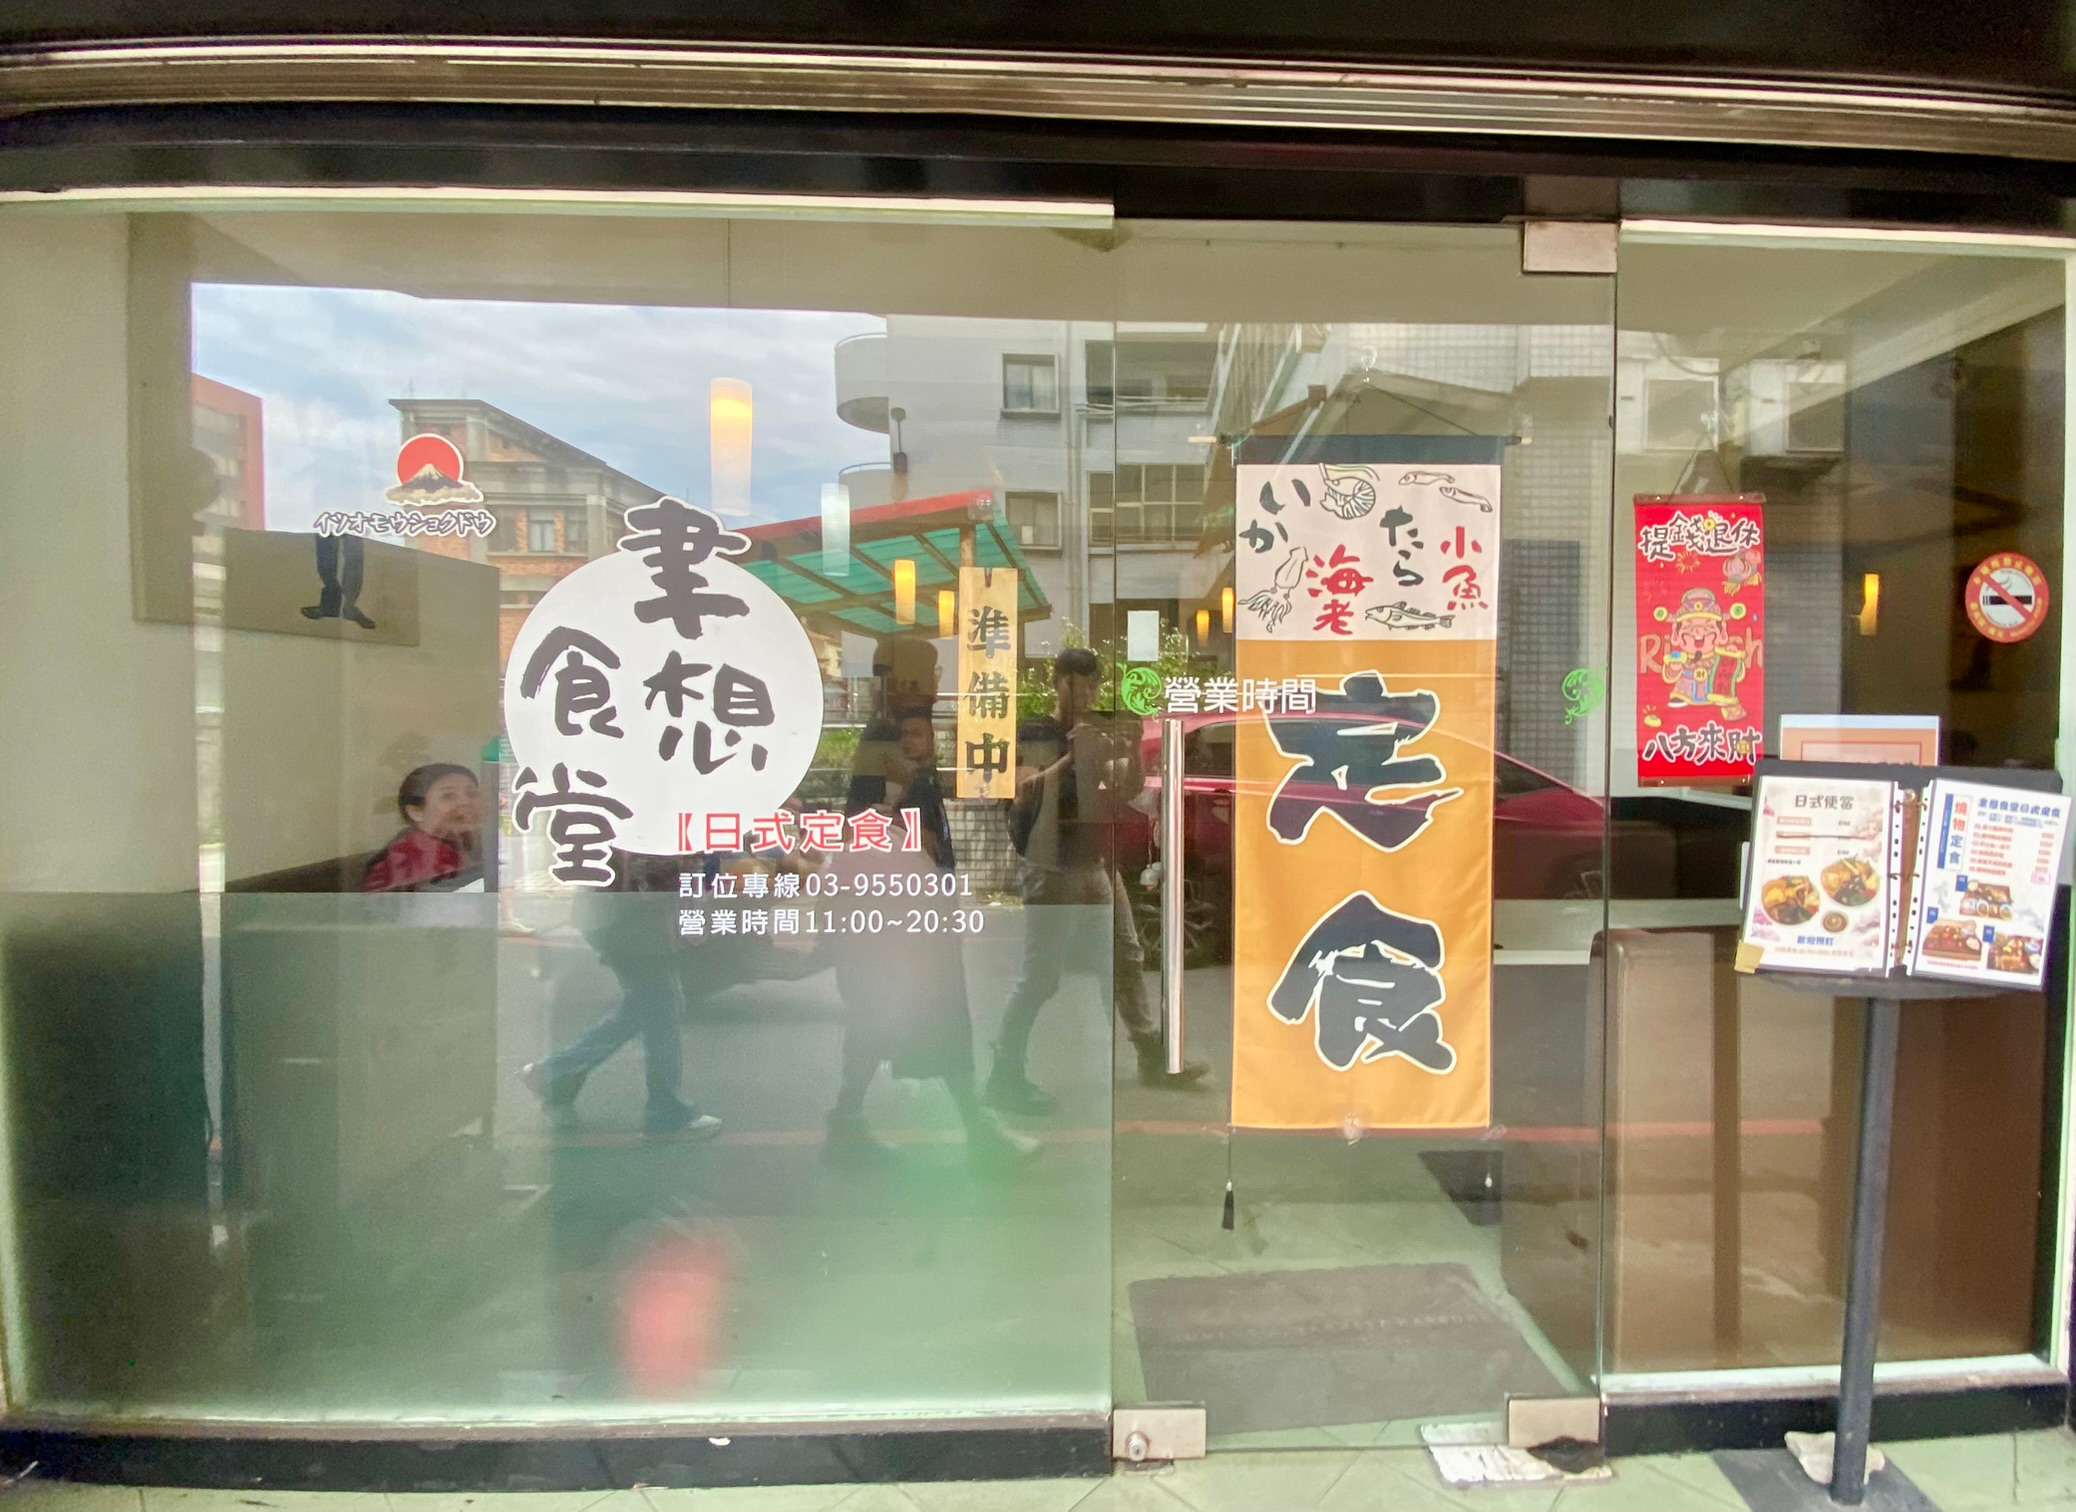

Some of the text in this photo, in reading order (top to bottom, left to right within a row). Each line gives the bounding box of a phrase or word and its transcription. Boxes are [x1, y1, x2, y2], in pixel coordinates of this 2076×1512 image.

[1239, 478, 1311, 553] いか
[1379, 505, 1424, 586] たら
[1305, 543, 1374, 635] 海老
[1440, 525, 1488, 610] 小魚
[964, 605, 1011, 783] 準備中
[1165, 676, 1317, 714] 營業時間
[514, 626, 634, 883] 食堂
[1643, 720, 1763, 764] 八方來財
[1795, 794, 1854, 810] 日式便當
[1263, 670, 1464, 1074] 定食
